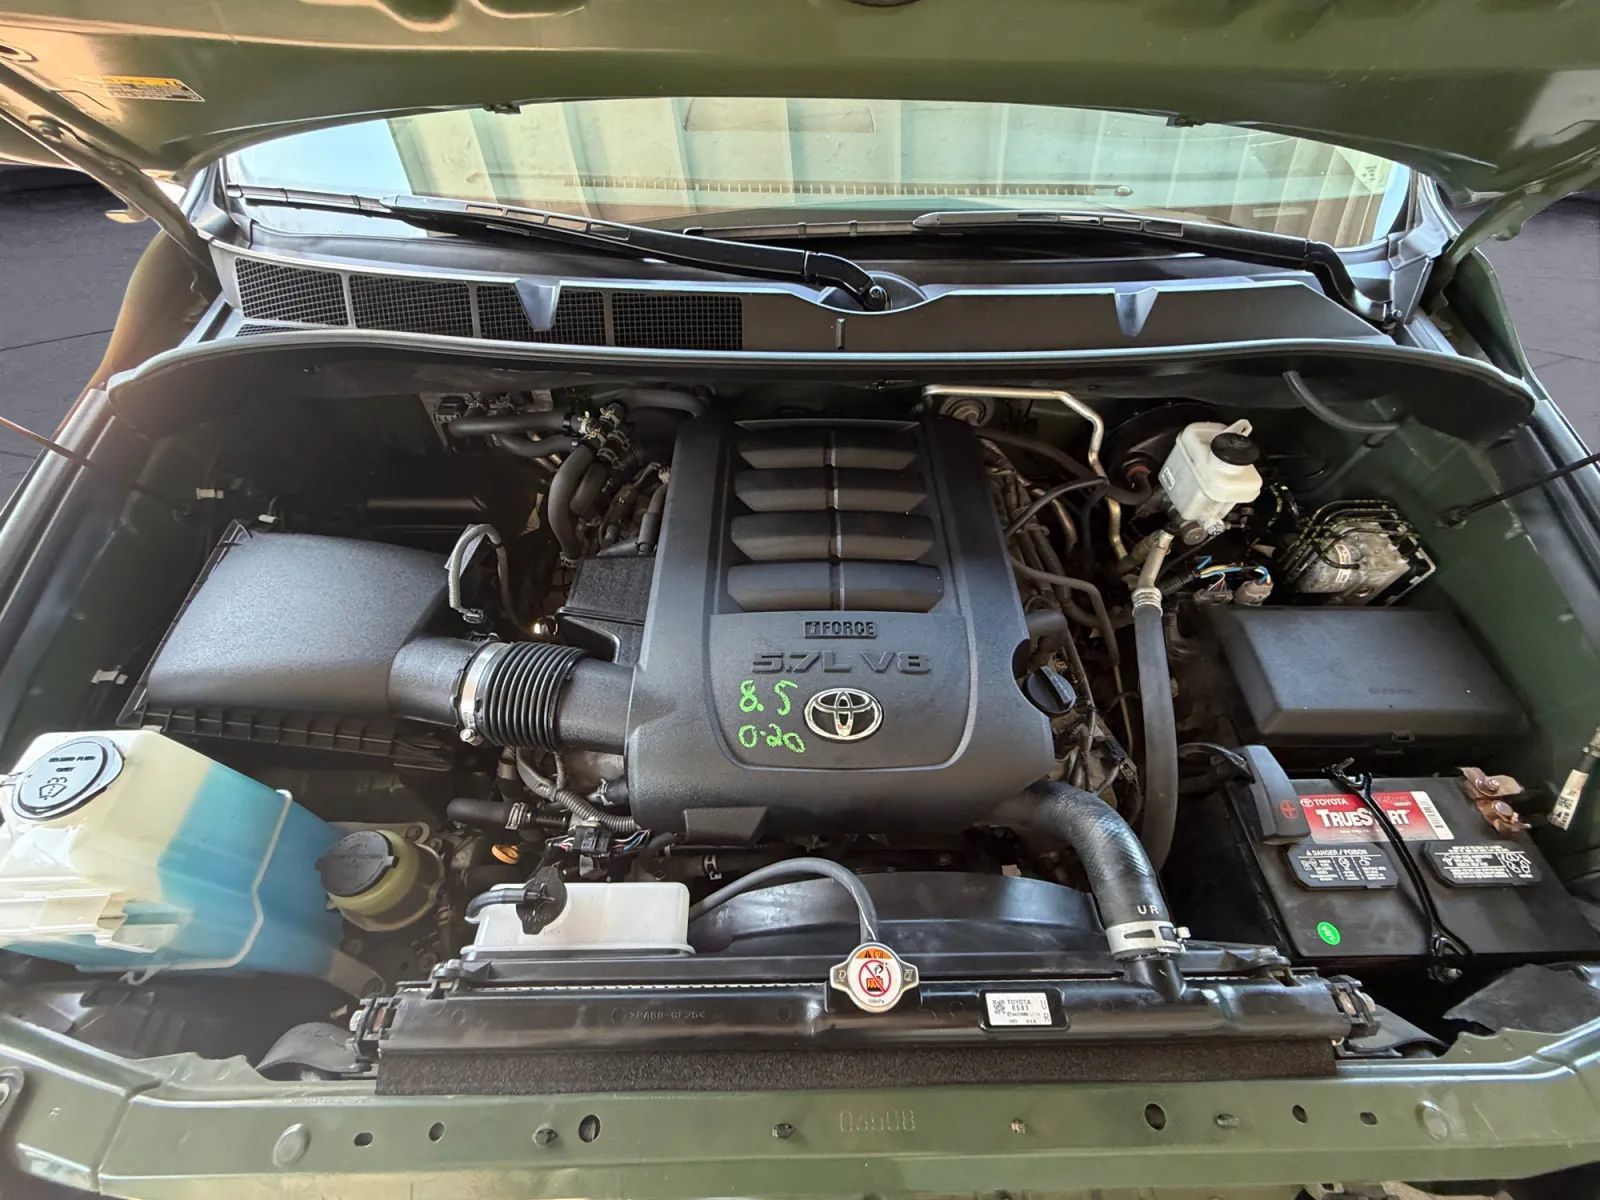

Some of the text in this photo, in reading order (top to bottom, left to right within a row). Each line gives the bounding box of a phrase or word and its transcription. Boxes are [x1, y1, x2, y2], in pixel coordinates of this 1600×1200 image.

[752, 651, 931, 675] 5.7L V8
[1314, 797, 1349, 806] TOYOTA
[1343, 848, 1368, 856] POISON
